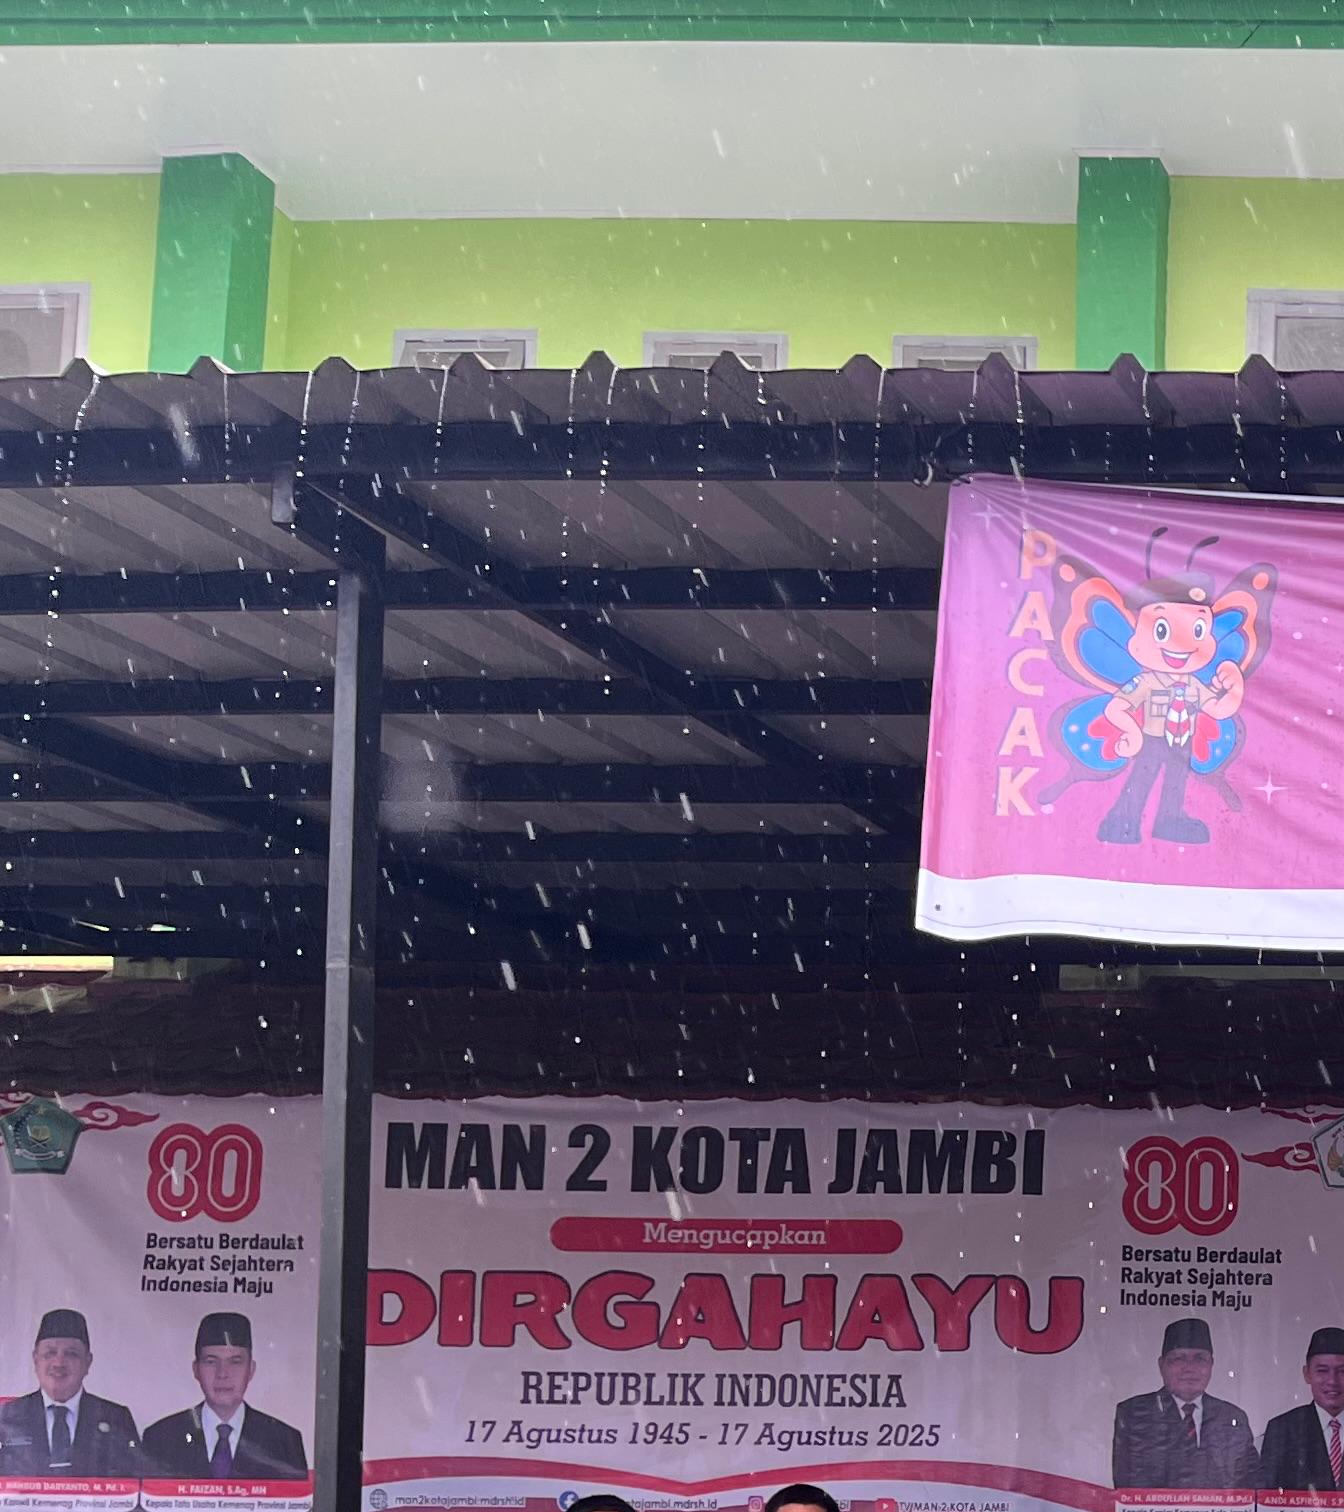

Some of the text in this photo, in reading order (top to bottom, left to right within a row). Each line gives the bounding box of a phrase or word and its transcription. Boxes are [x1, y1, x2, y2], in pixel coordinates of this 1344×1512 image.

[994, 528, 1057, 818] PACAK
[385, 1121, 1046, 1196] MAN 2 KOTA JAMBI
[147, 1122, 263, 1223] 80
[1122, 1135, 1240, 1236] 80
[146, 1233, 304, 1250] Bersatu Berdaulat
[642, 1222, 827, 1249] Mengucapkan
[143, 1254, 294, 1276] Rakyat Sejahtera
[1122, 1245, 1282, 1264] Bersatu Berdaulat
[141, 1276, 273, 1297] Indonesia Maju
[1121, 1267, 1273, 1290] Rakyat Sejahtera
[366, 1268, 1085, 1352] DIRGAHAYU
[1120, 1289, 1252, 1311] Indonesia Maju
[520, 1371, 907, 1408] REPUBLIK INDONESIA
[464, 1420, 496, 1444] 17
[502, 1421, 618, 1450] Agustus
[628, 1423, 691, 1446] 1945
[717, 1424, 750, 1447] 17
[754, 1424, 869, 1452] Agustus
[876, 1425, 940, 1448] 2025
[950, 1502, 976, 1512] KOTA
[979, 1502, 1010, 1512] JAMBI
[1145, 1494, 1191, 1503] ABDULLAH
